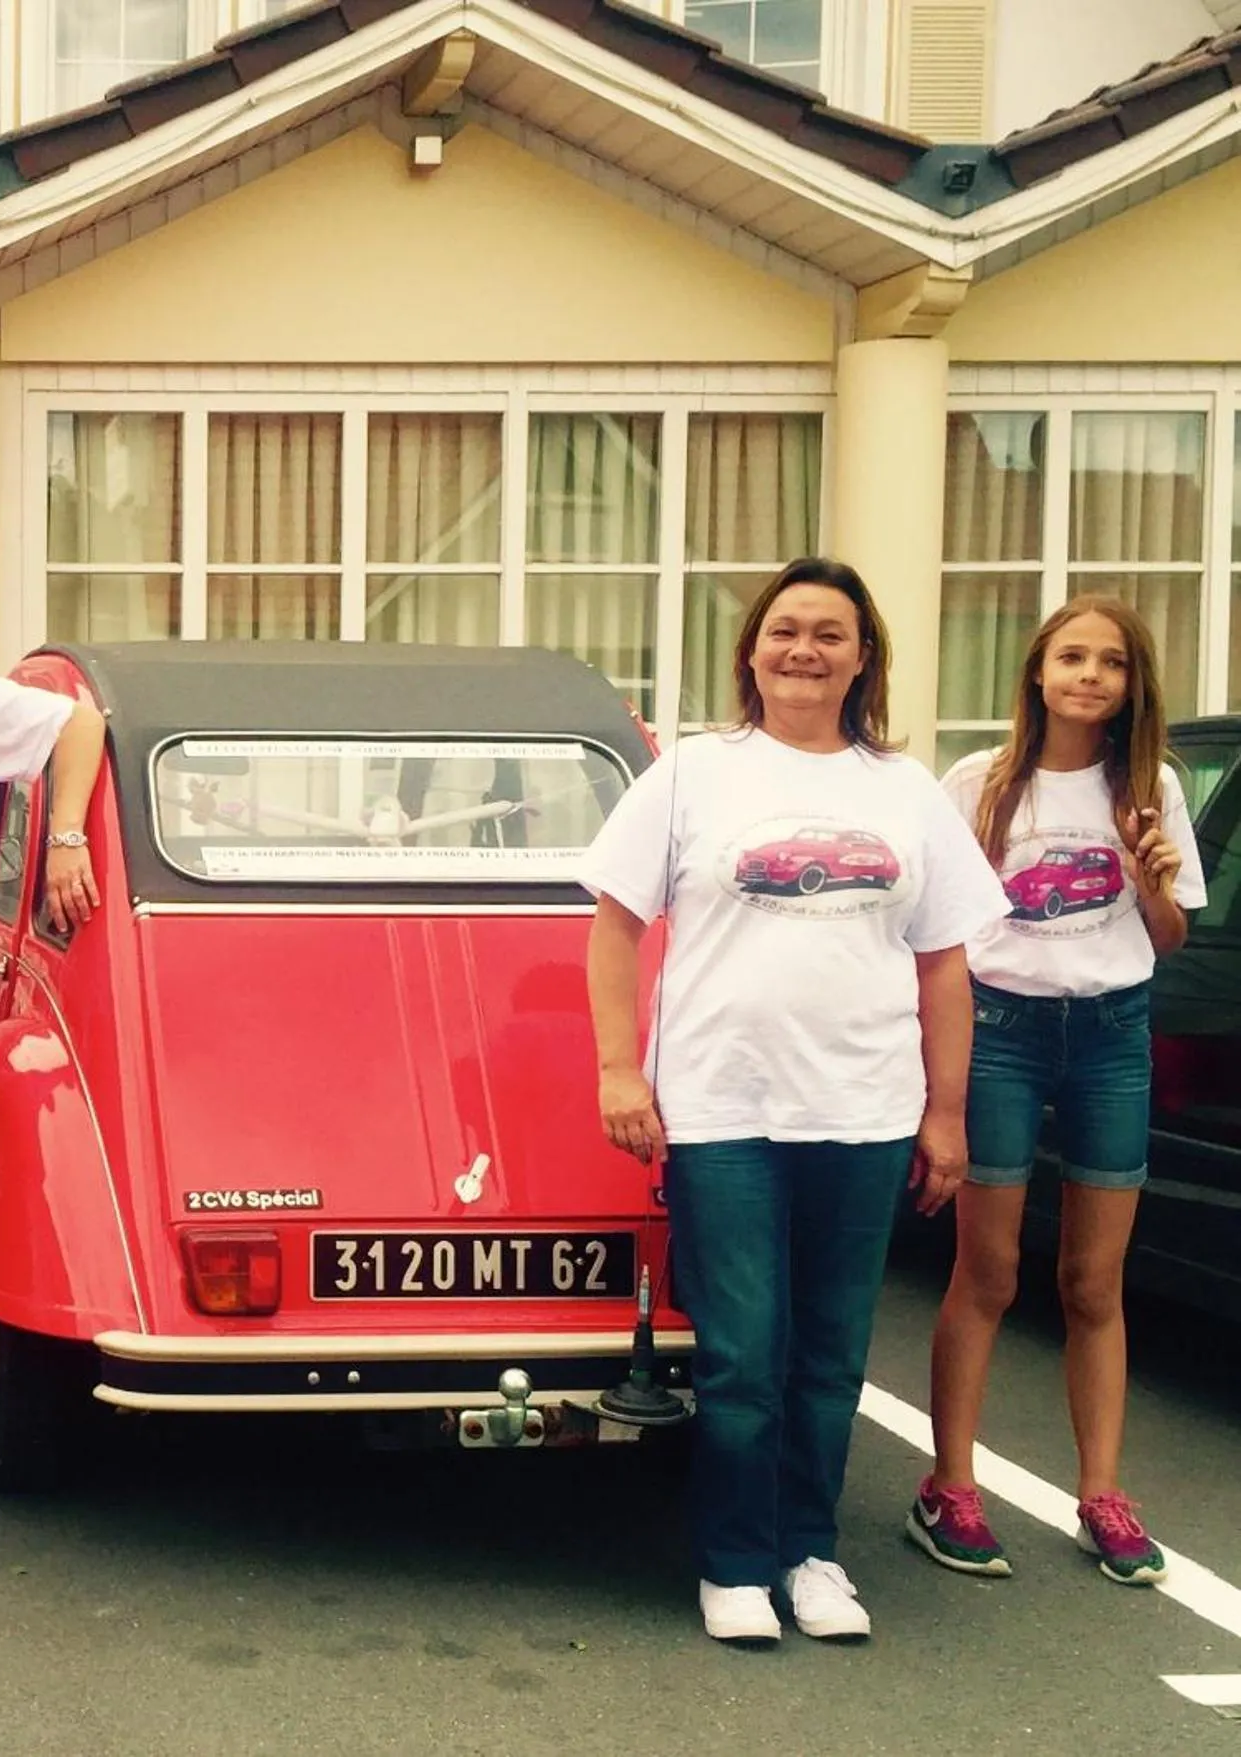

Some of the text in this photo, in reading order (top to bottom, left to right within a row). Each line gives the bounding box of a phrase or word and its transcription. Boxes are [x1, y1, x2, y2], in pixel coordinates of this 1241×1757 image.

[188, 1189, 319, 1211] 2CV6 Spécial
[335, 1240, 608, 1291] 3120 MT 62
